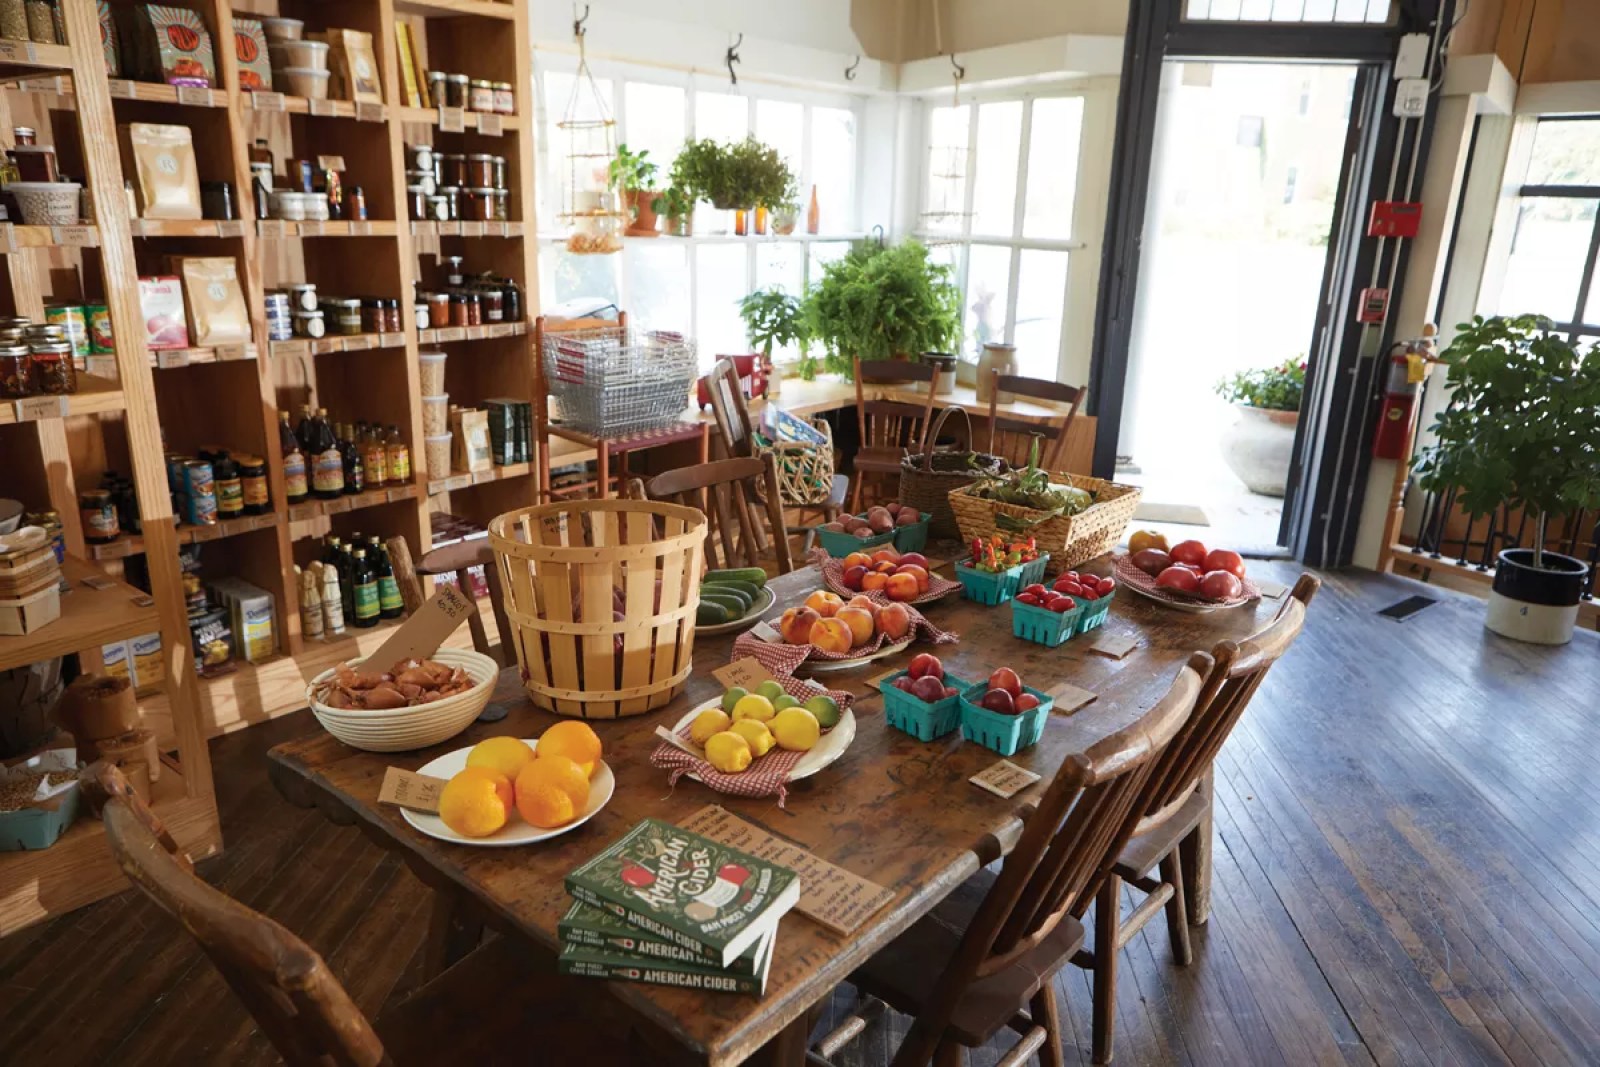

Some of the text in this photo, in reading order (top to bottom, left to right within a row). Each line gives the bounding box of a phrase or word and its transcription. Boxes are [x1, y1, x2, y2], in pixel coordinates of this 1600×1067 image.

[634, 838, 689, 908] AMERICAN
[678, 847, 710, 896] CIDER
[627, 910, 702, 955] AMERICAN CIDER
[638, 941, 695, 962] AMERICAN
[643, 968, 737, 992] AMERICAN CIDER
